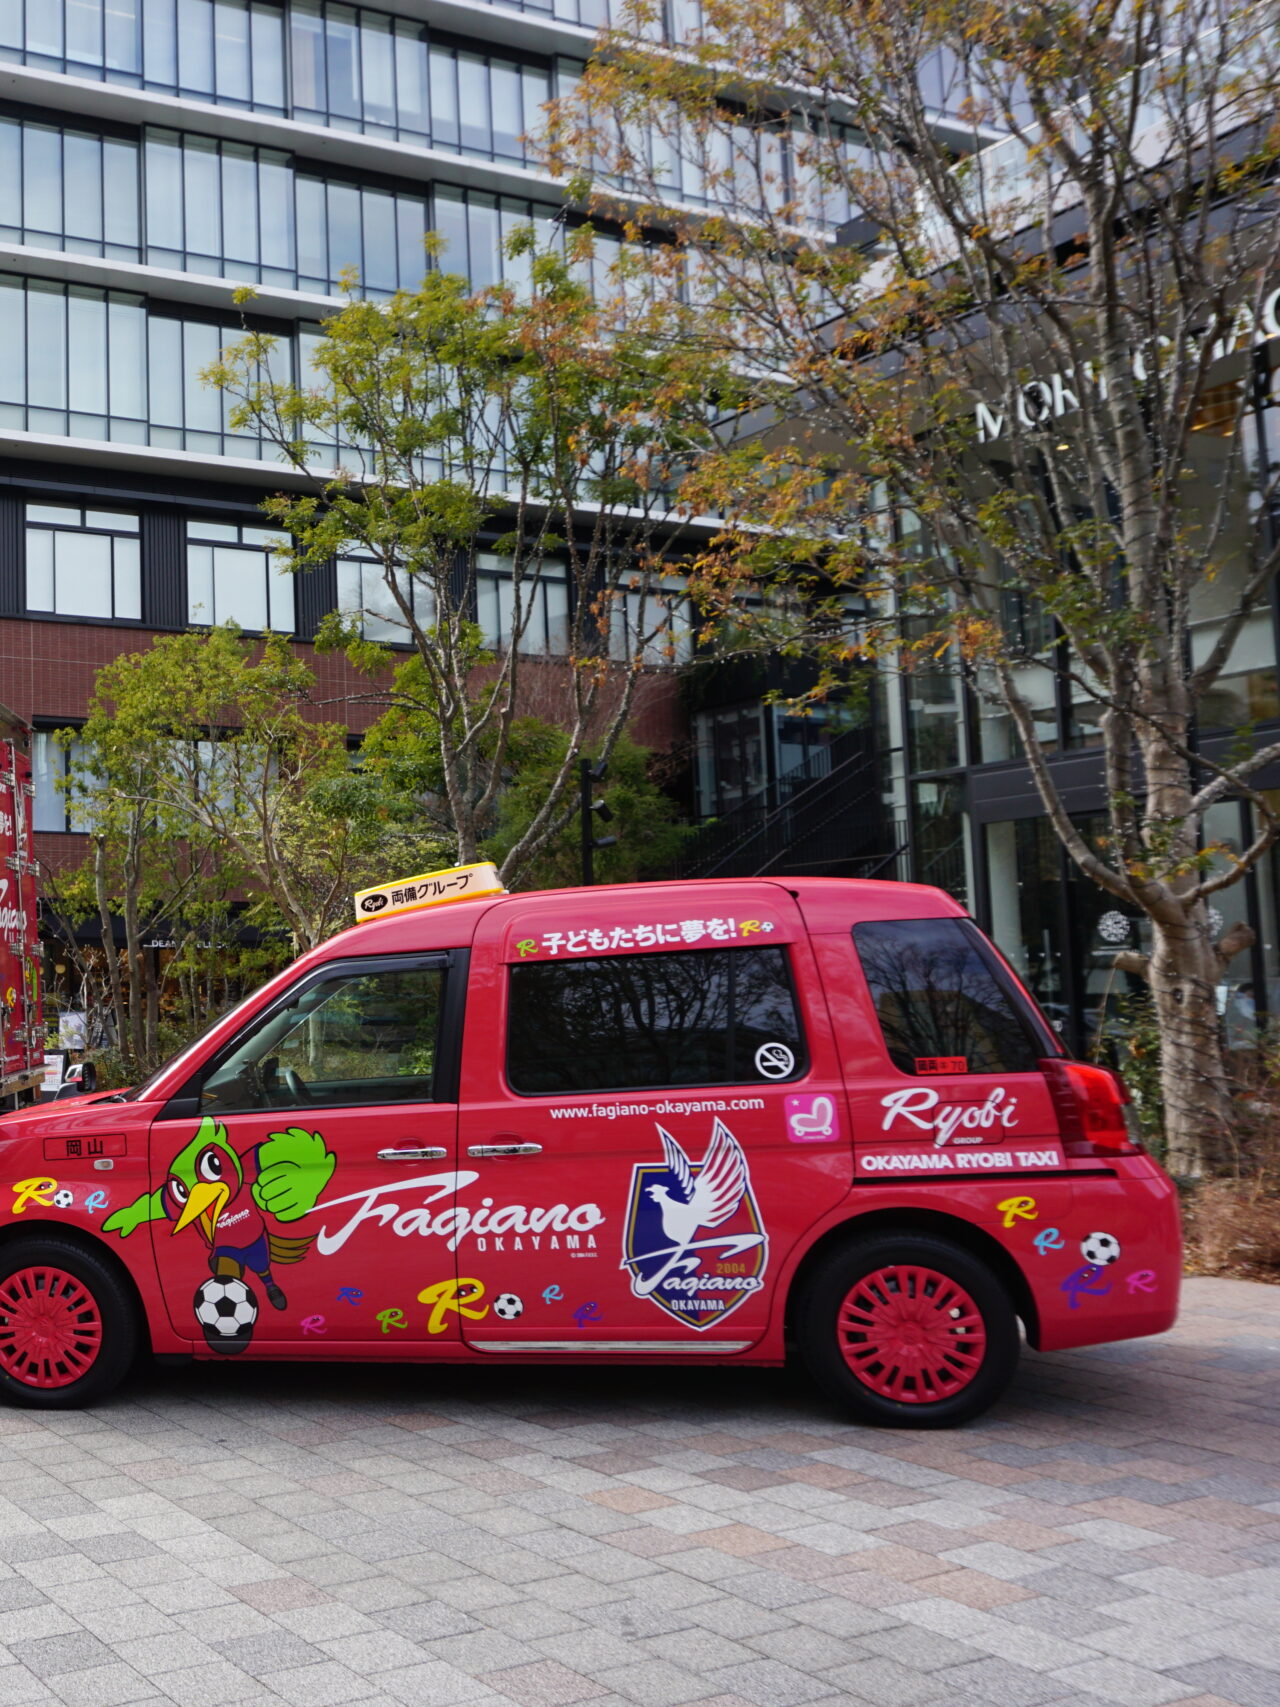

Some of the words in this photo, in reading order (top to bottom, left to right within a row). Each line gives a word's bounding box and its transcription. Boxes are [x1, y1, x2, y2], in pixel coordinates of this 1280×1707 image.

[391, 873, 473, 905] 両備グループ
[542, 918, 737, 955] 子どもたちに夢を!
[549, 1098, 765, 1120] www.fagiano-okayama.com
[880, 1087, 1019, 1149] Ryobi
[66, 1138, 104, 1157] 岡山
[861, 1154, 955, 1171] OKAYAMA
[956, 1152, 1013, 1168] RYOBI
[1015, 1151, 1060, 1167] TAXI
[305, 1170, 606, 1256] Fagiano
[477, 1234, 597, 1251] OKAYAMA
[625, 1233, 765, 1297] Fagiano
[716, 1263, 745, 1273] 2004
[671, 1299, 725, 1311] OKAYAMA
